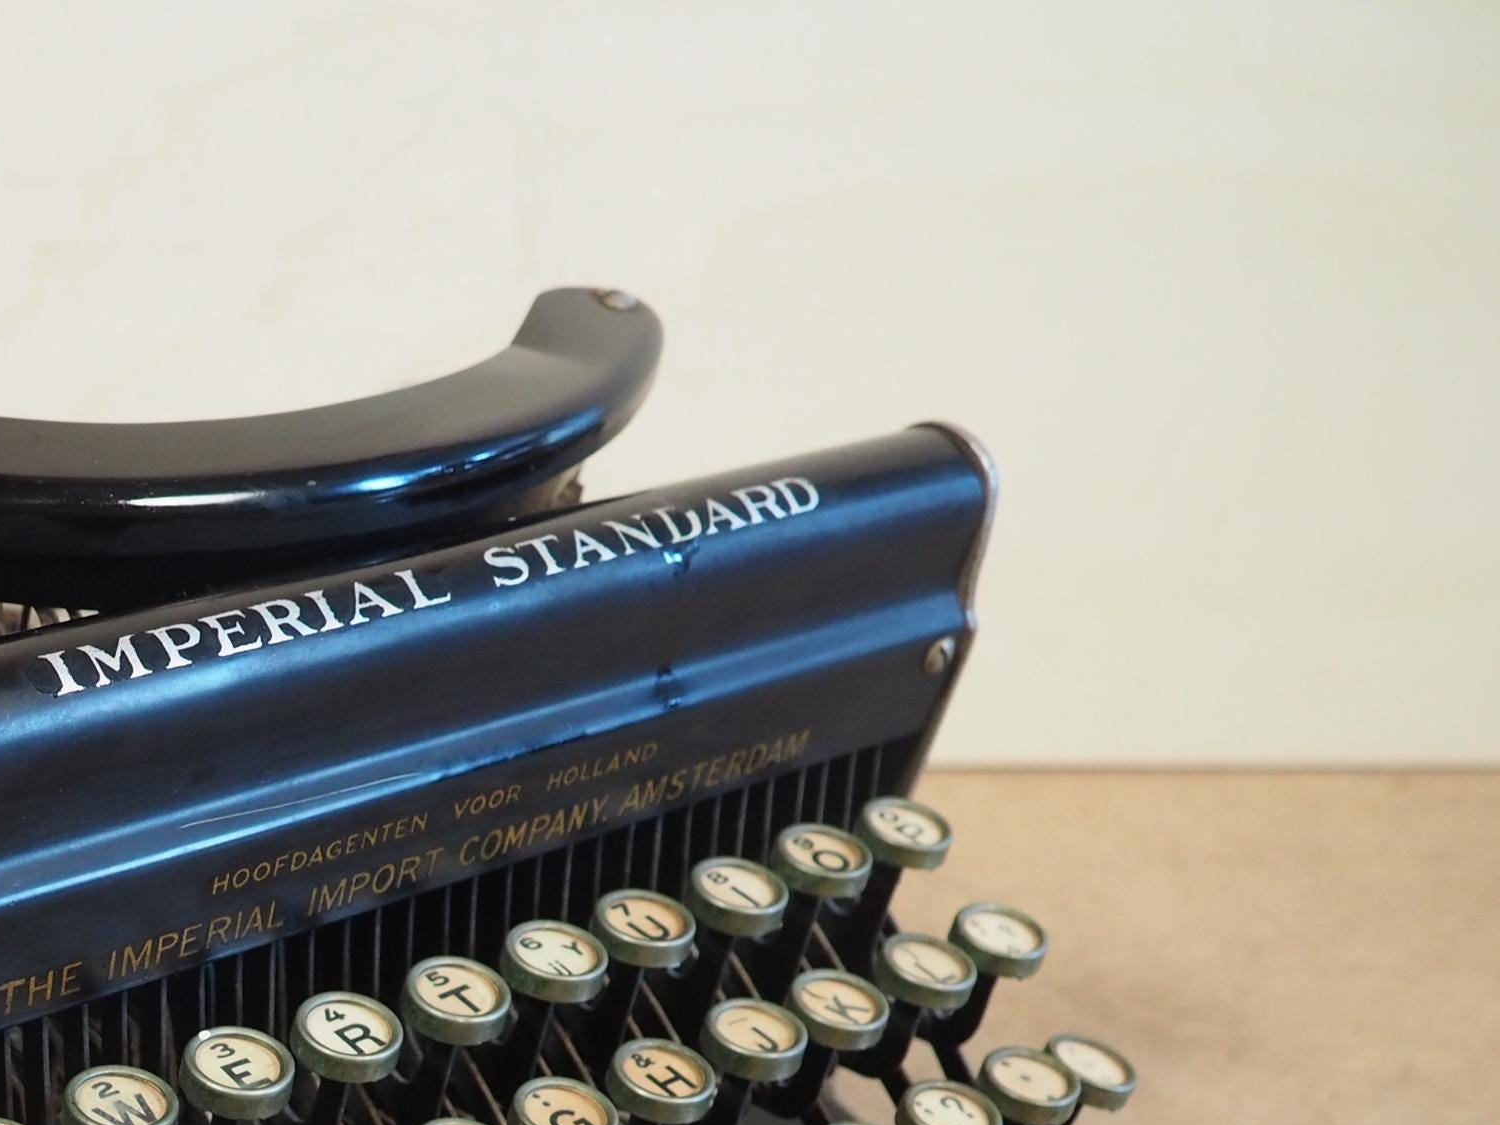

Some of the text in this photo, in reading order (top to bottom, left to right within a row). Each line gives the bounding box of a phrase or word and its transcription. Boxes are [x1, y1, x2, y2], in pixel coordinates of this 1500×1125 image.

[37, 476, 822, 697] IMPERIAL STANDARD
[211, 741, 659, 895] HOOFDAGENTEN VOOR HOLLAND
[106, 901, 285, 980] IMPERIAL
[306, 847, 445, 917] IMPORT
[619, 729, 812, 818] AMSTERDAM
[707, 872, 728, 885] 8
[612, 903, 630, 916] 7
[627, 915, 670, 940] U
[520, 938, 543, 950] 6
[425, 971, 450, 987] 5
[438, 983, 481, 1014] T
[825, 995, 870, 1025] K
[324, 1008, 346, 1022] 4
[209, 1043, 235, 1059] 3
[333, 1023, 387, 1056] R
[752, 1026, 780, 1052] J
[220, 1057, 272, 1089] E
[631, 1053, 655, 1068] &
[91, 1081, 120, 1099] 2
[646, 1065, 698, 1097] H
